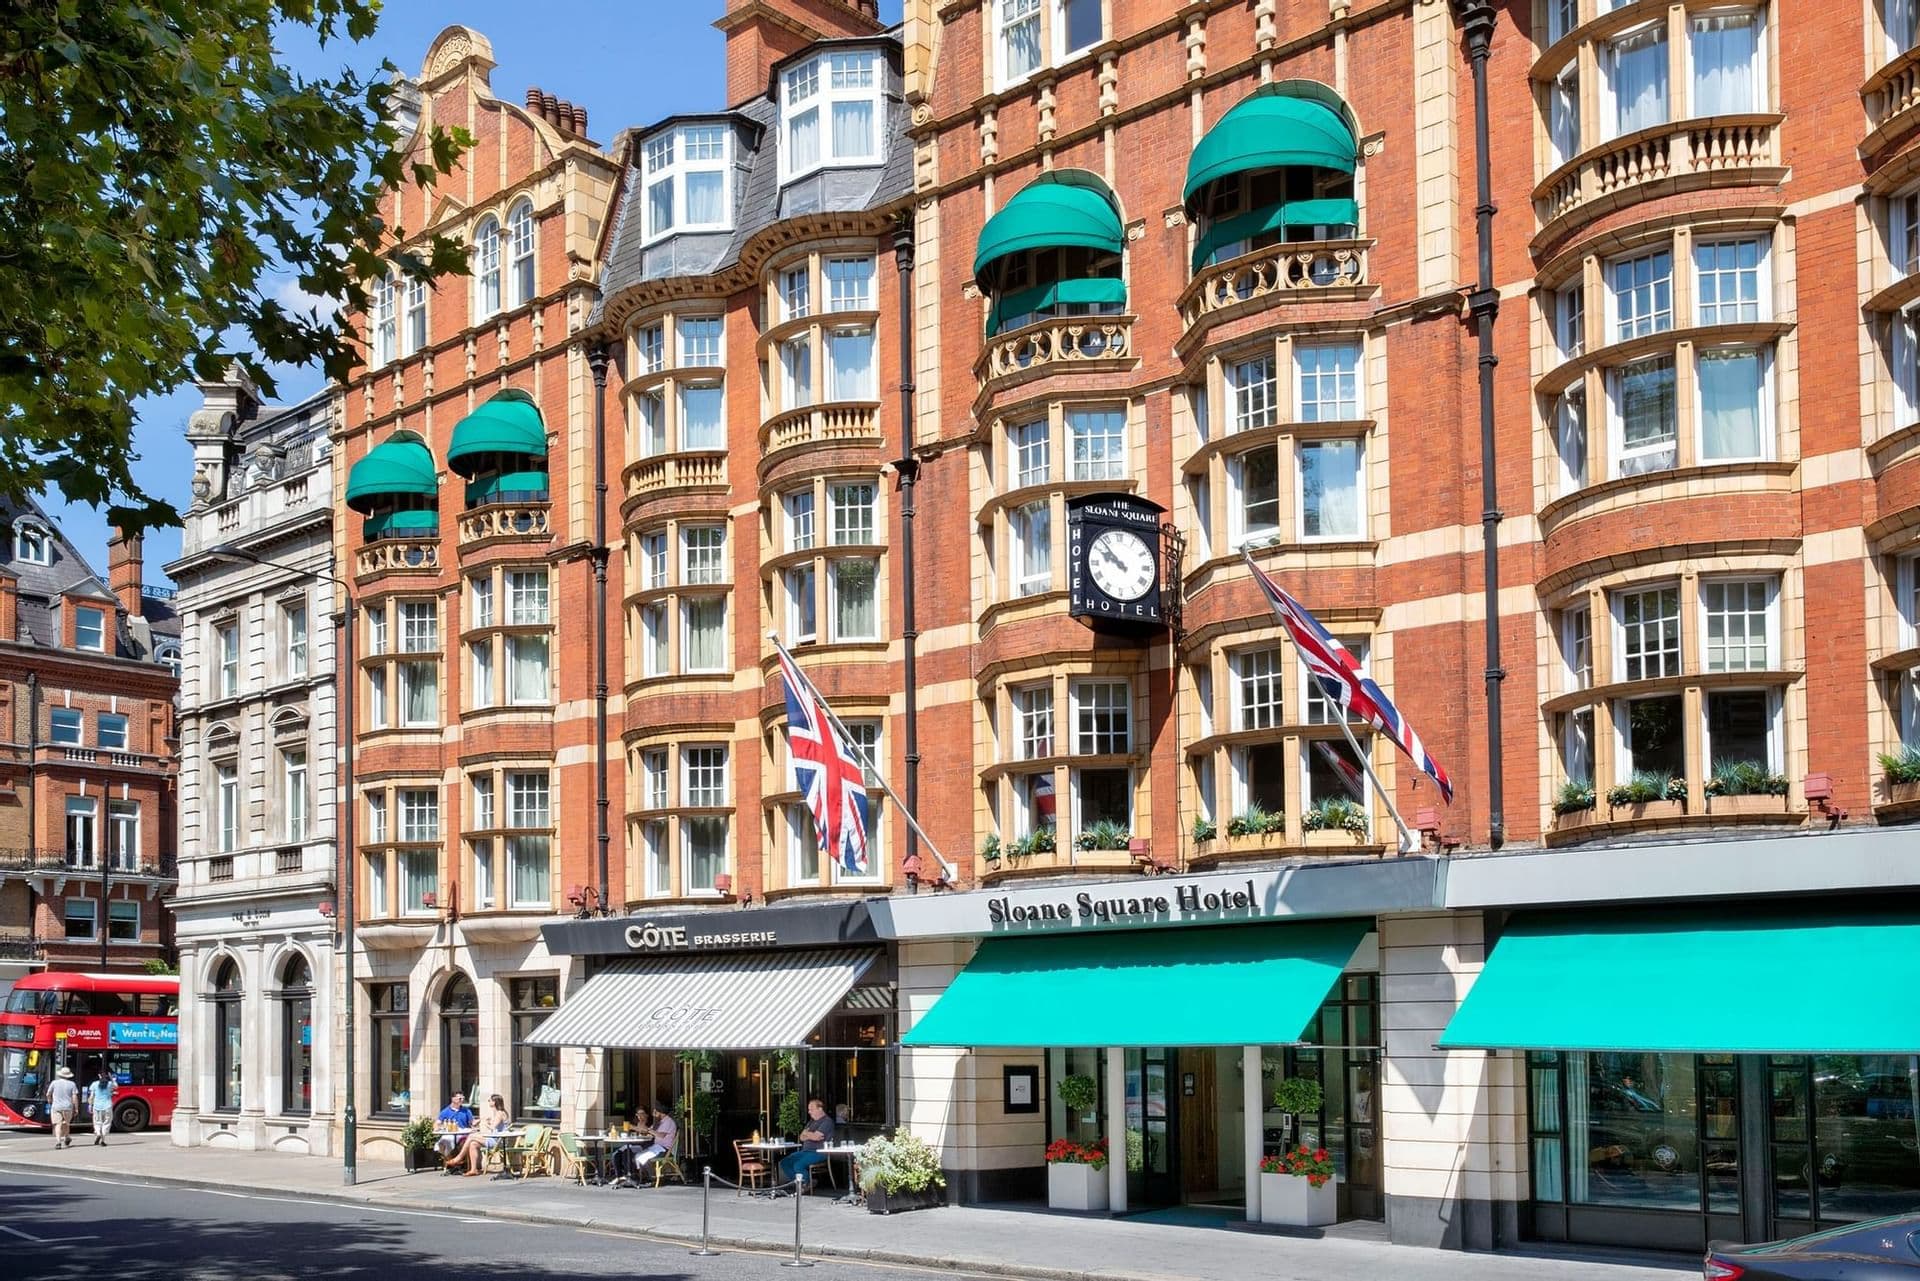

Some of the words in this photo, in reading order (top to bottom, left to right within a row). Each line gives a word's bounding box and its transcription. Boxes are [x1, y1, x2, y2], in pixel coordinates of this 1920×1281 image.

[1085, 505, 1119, 518] SLOANE
[1121, 511, 1157, 523] SQUARE
[1072, 528, 1081, 605] HOTEL
[1086, 598, 1157, 617] HOTEL
[988, 896, 1073, 923] Sloane
[1077, 891, 1170, 921] Square
[1174, 879, 1259, 911] Hotel
[624, 921, 688, 949] CÔTE
[694, 931, 777, 946] BRASSERIE
[122, 1028, 147, 1038] Want
